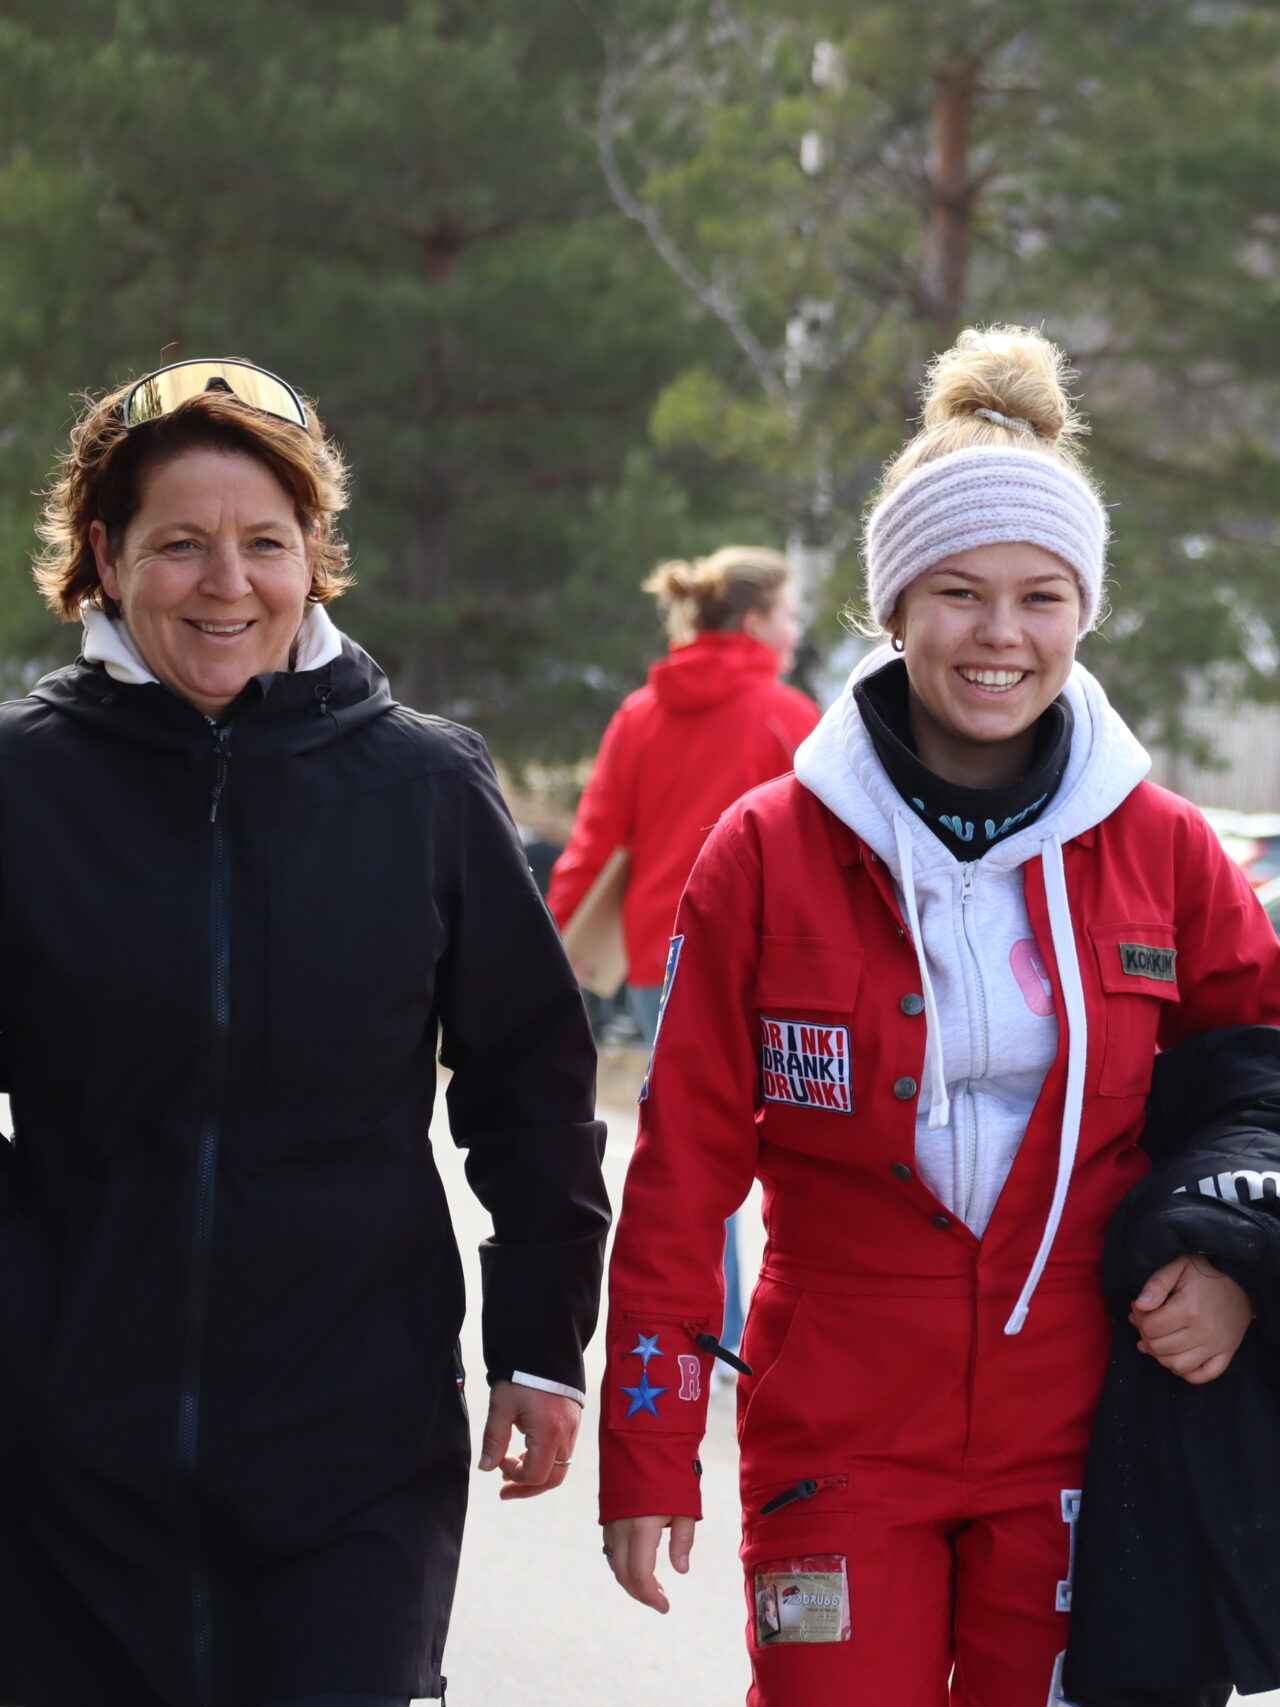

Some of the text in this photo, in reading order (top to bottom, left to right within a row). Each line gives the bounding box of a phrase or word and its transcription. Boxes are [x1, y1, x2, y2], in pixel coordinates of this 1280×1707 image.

[763, 1046, 845, 1083] DRANK!
[763, 1070, 849, 1110] DRUNK!
[677, 1354, 701, 1401] R
